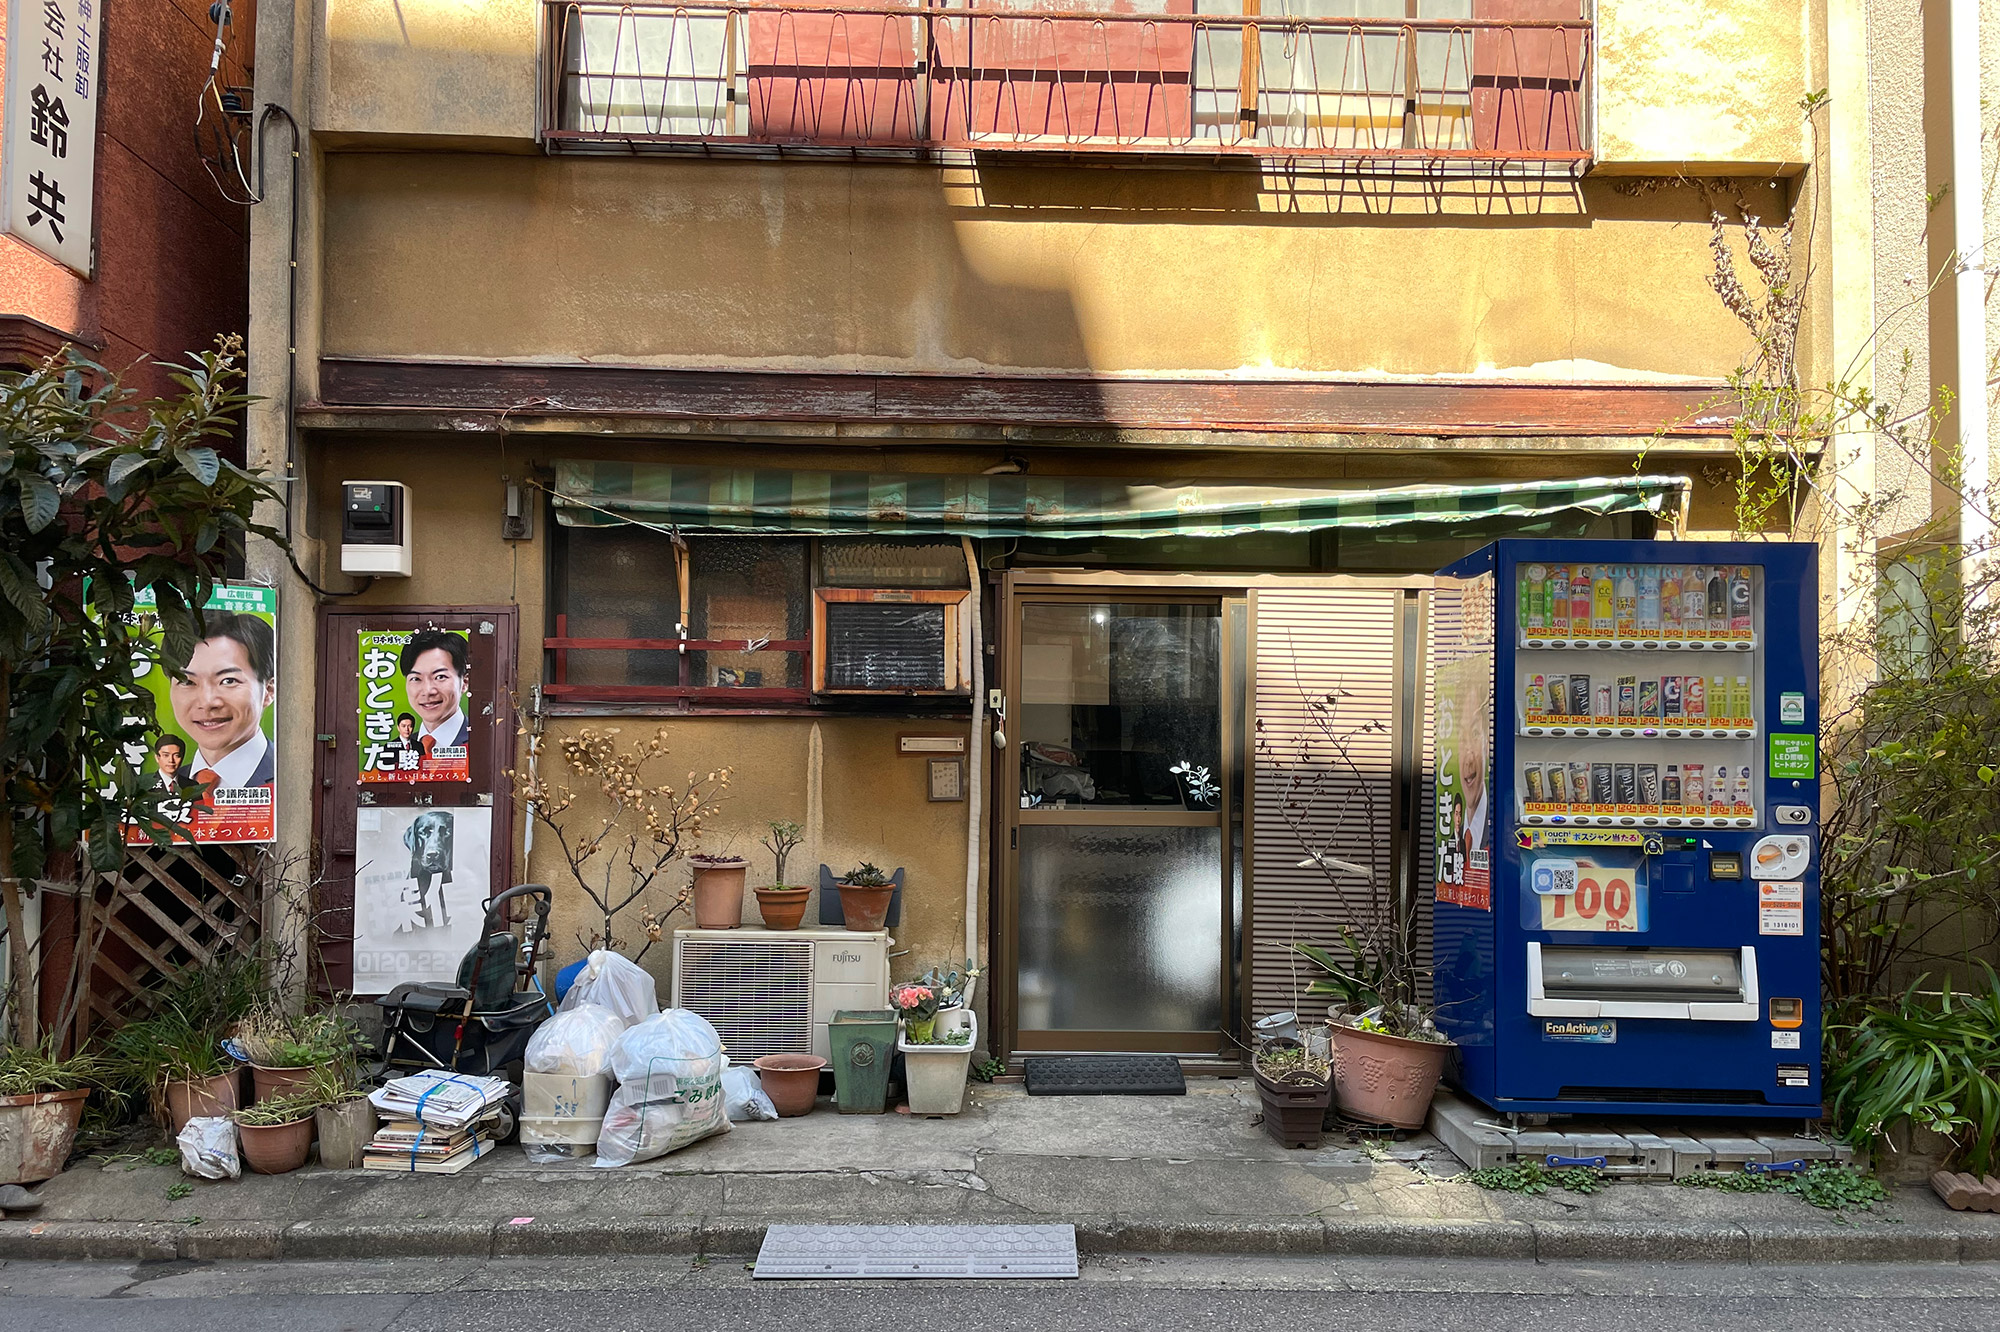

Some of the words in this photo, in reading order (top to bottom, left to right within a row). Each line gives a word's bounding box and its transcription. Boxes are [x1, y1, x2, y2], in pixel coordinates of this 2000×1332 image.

[363, 648, 398, 771] おときた
[397, 750, 420, 771] 駿
[361, 772, 467, 781] もっと、新しい日本をつくろう
[215, 788, 270, 798] 参議院議員
[1437, 697, 1454, 883] おときた
[832, 951, 861, 964] FUJITSU
